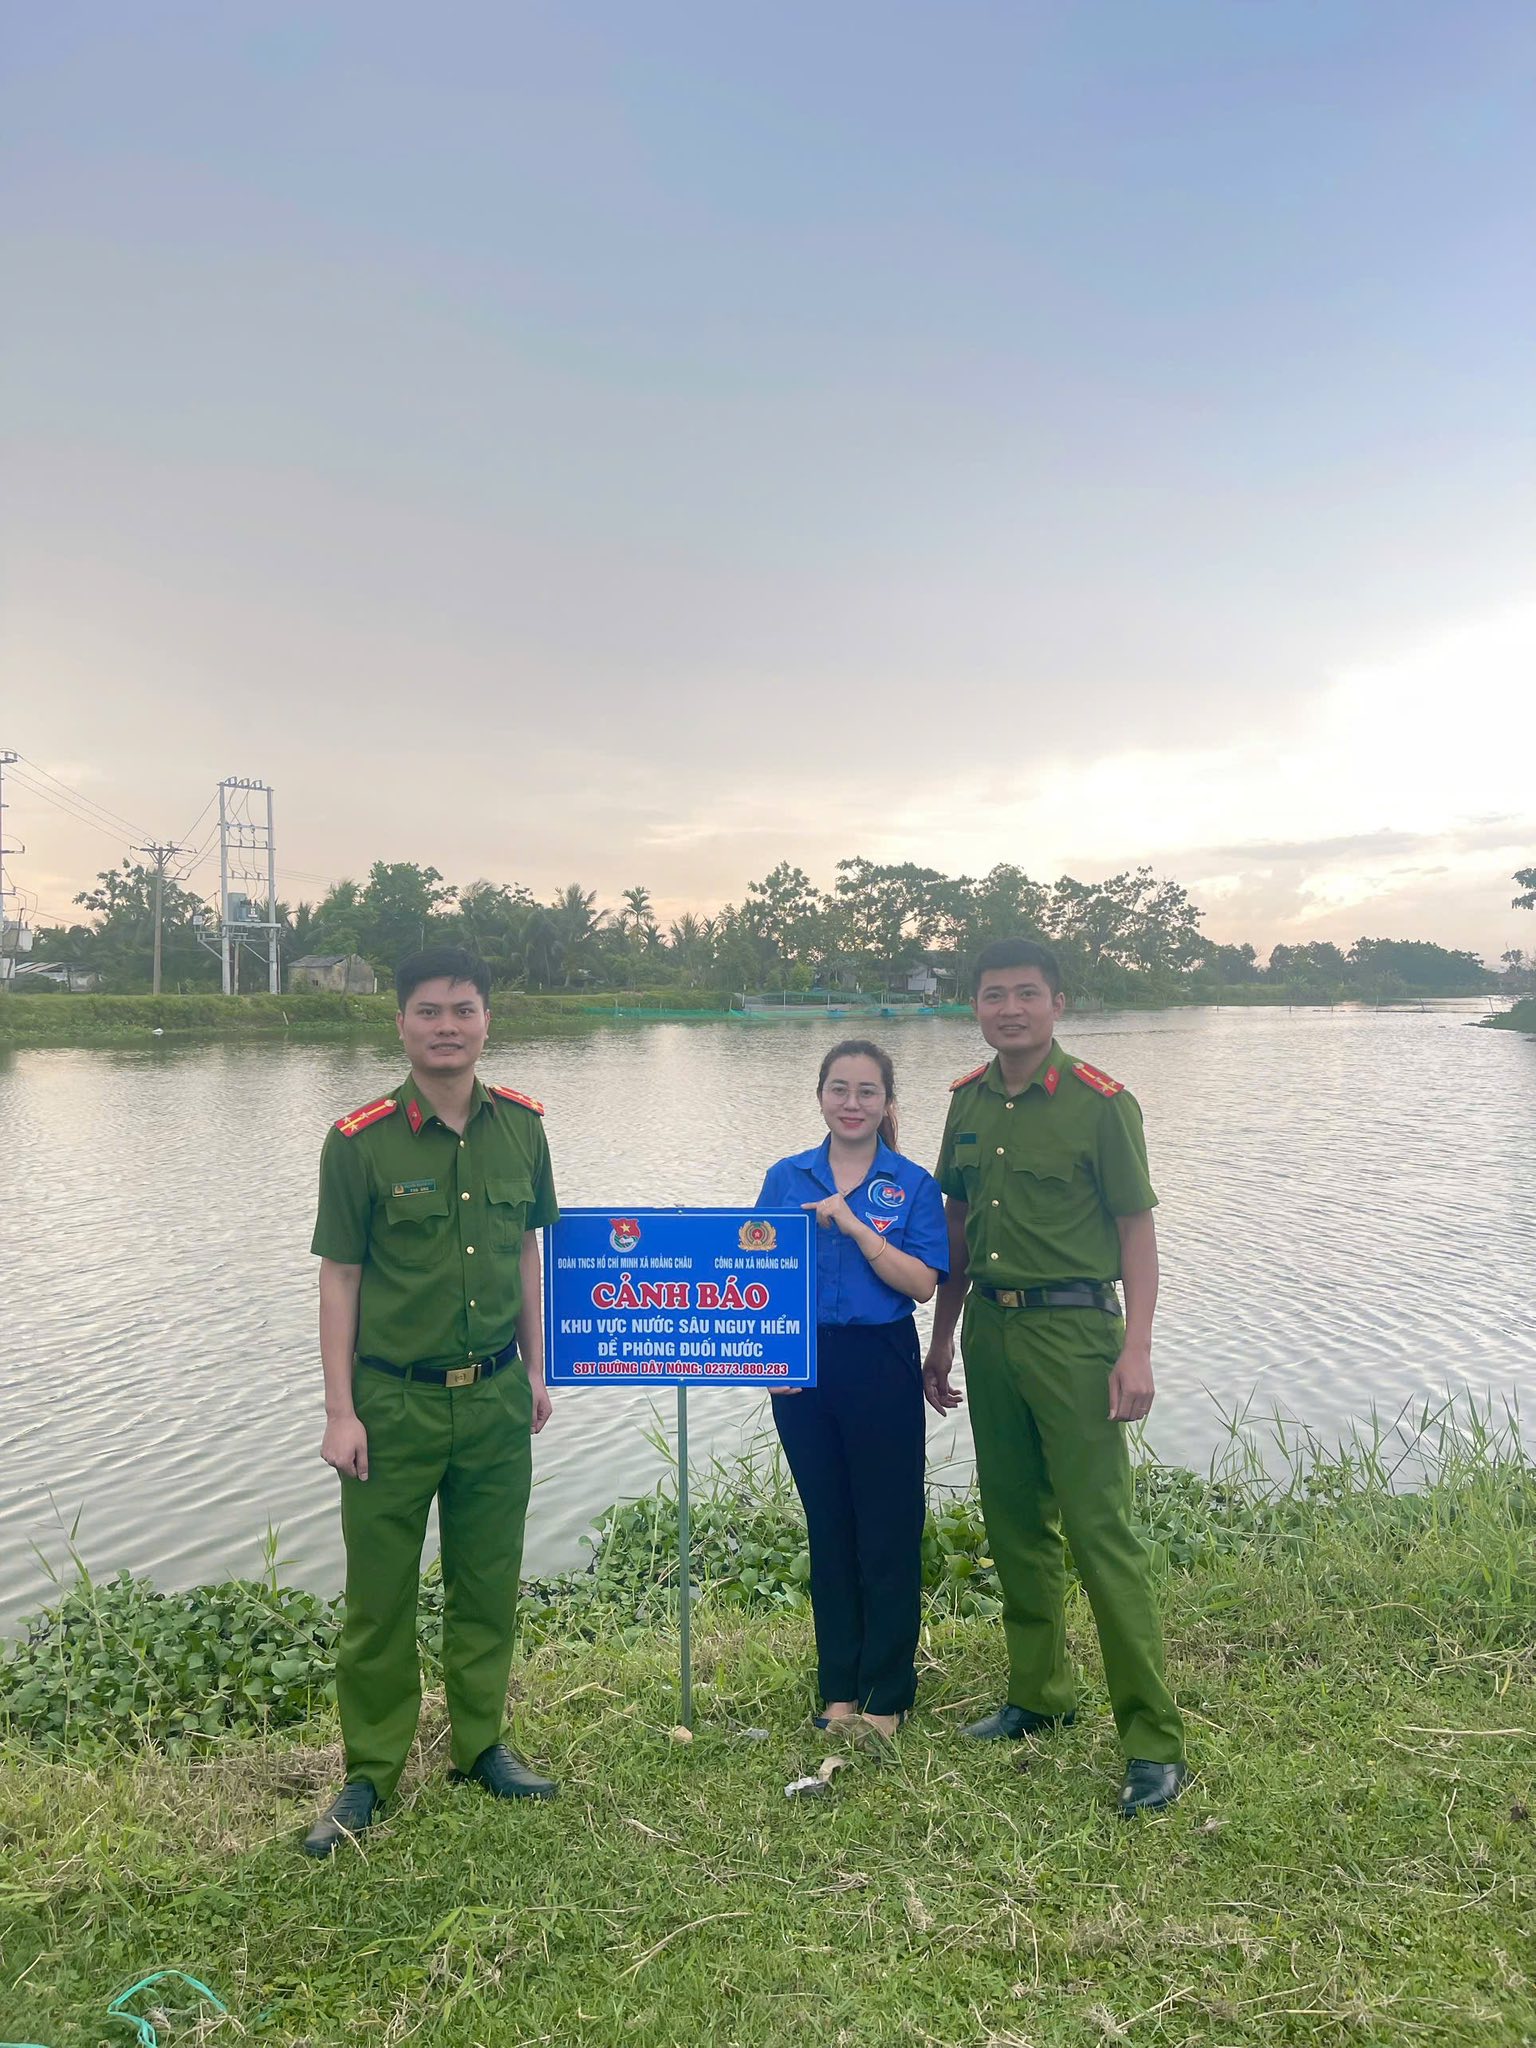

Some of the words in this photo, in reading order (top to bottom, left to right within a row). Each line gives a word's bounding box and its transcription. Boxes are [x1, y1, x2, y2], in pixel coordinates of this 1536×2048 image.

[558, 1257, 576, 1269] ĐOÀN
[578, 1258, 596, 1269] TNCS
[608, 1256, 619, 1269] CHÍ
[621, 1258, 638, 1269] MINH
[640, 1256, 649, 1269] XÃ
[675, 1256, 693, 1269] CHÂU
[714, 1256, 733, 1269] CÔNG
[735, 1258, 744, 1269] AN
[781, 1256, 799, 1270] CHÂU
[591, 1272, 690, 1309] CẢNH
[696, 1275, 769, 1310] BÁO
[562, 1319, 592, 1334] KHU
[597, 1318, 627, 1336] VỰC
[632, 1315, 674, 1334] NƯỚC
[679, 1317, 710, 1334] SÂU
[715, 1319, 756, 1334] NGUY
[761, 1314, 800, 1335] HIỂM
[598, 1337, 618, 1356] ĐỀ
[623, 1339, 675, 1356] PHÒNG
[680, 1338, 716, 1357] ĐUỐI
[721, 1339, 763, 1357] NƯỚC
[573, 1362, 596, 1375] SĐT
[598, 1359, 638, 1375] ĐƯỜNG
[641, 1360, 664, 1375] DÂY
[666, 1361, 703, 1375] NÓNG:
[705, 1363, 788, 1376] 02373.880.283
